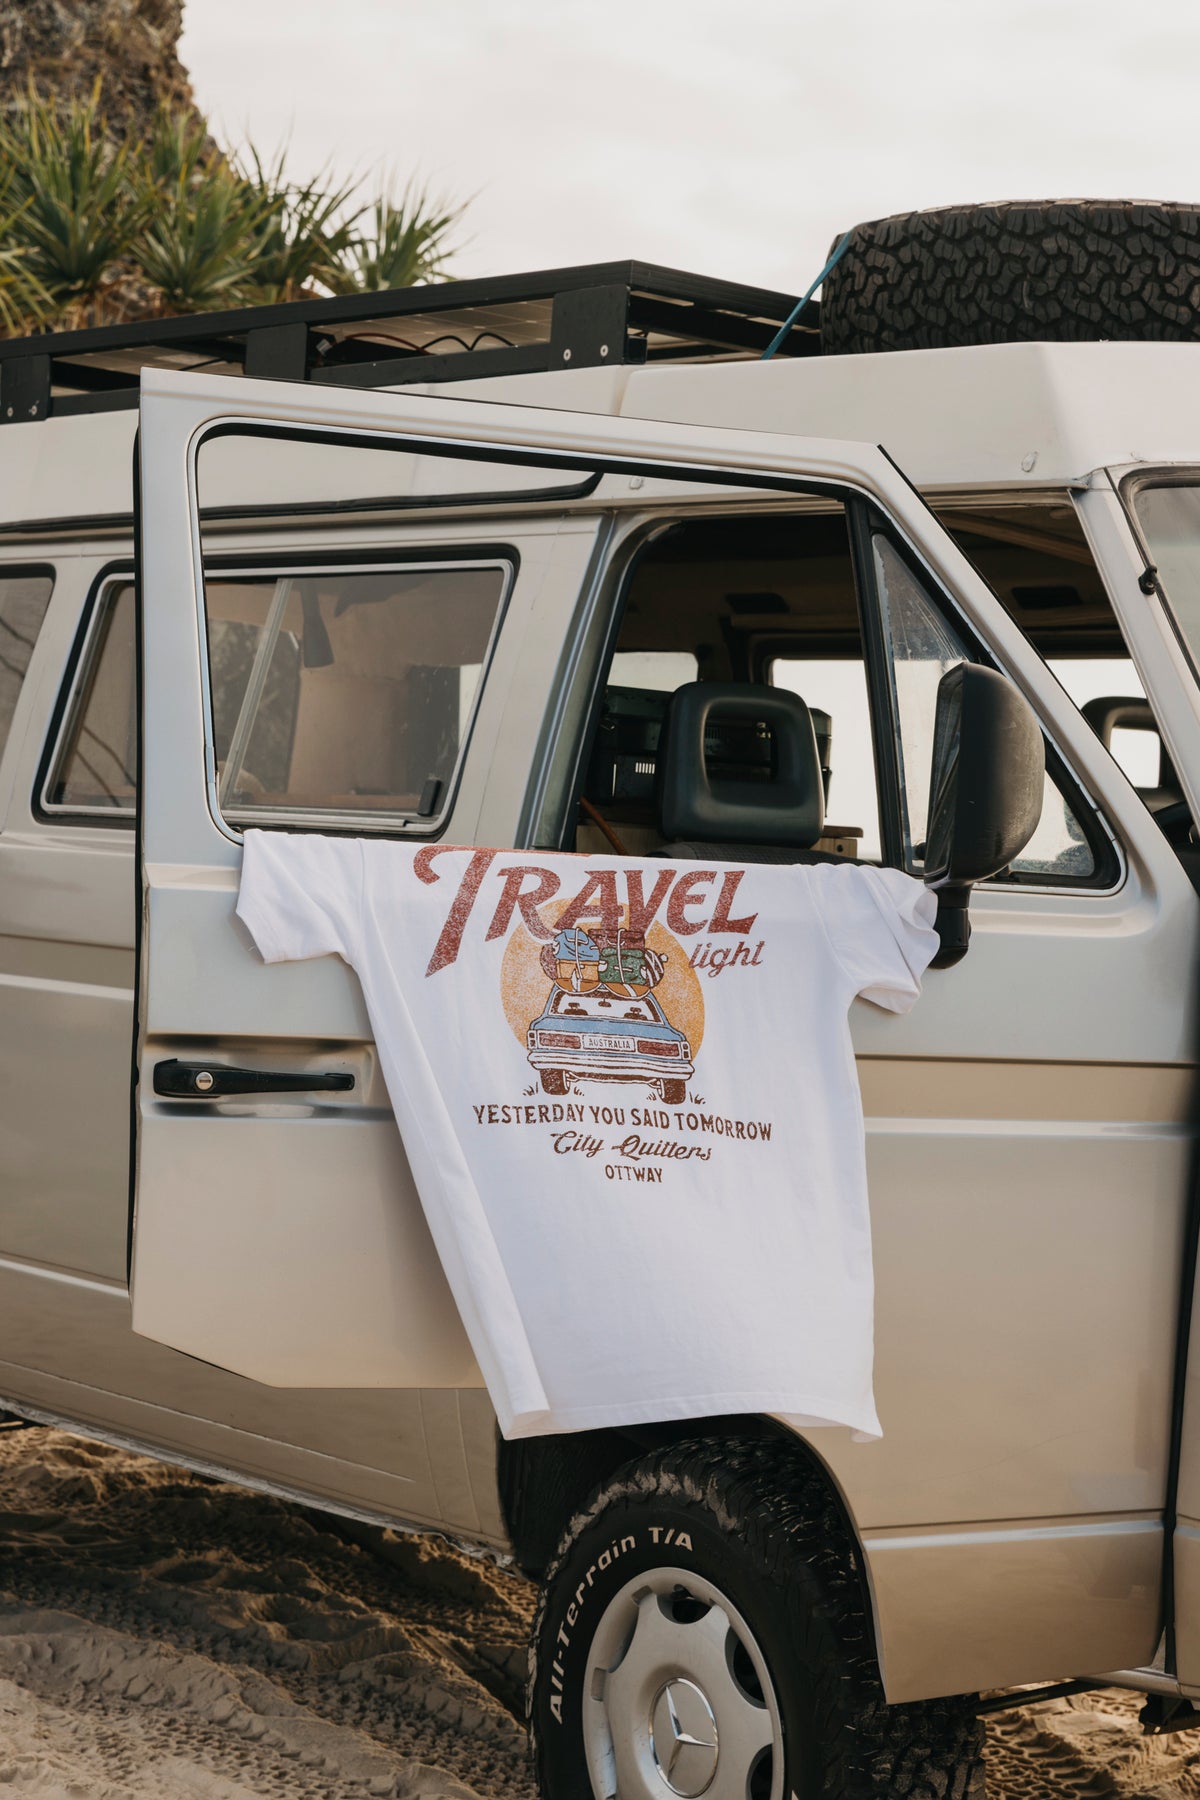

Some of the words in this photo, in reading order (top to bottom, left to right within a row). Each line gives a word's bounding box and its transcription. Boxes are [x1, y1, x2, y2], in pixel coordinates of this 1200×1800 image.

[413, 845, 759, 978] TRAVEL
[690, 941, 764, 978] light
[588, 1038, 631, 1049] AUSTRALIA
[473, 1104, 585, 1125] YESTERDAY
[589, 1107, 625, 1126] YOU
[631, 1109, 671, 1129] SAID
[676, 1112, 772, 1141] TOMORROW
[550, 1130, 604, 1157] City
[612, 1134, 712, 1161] Quitters
[605, 1165, 663, 1183] OTTWAY
[550, 1534, 637, 1725] All-Terrain
[648, 1527, 693, 1552] T/A
